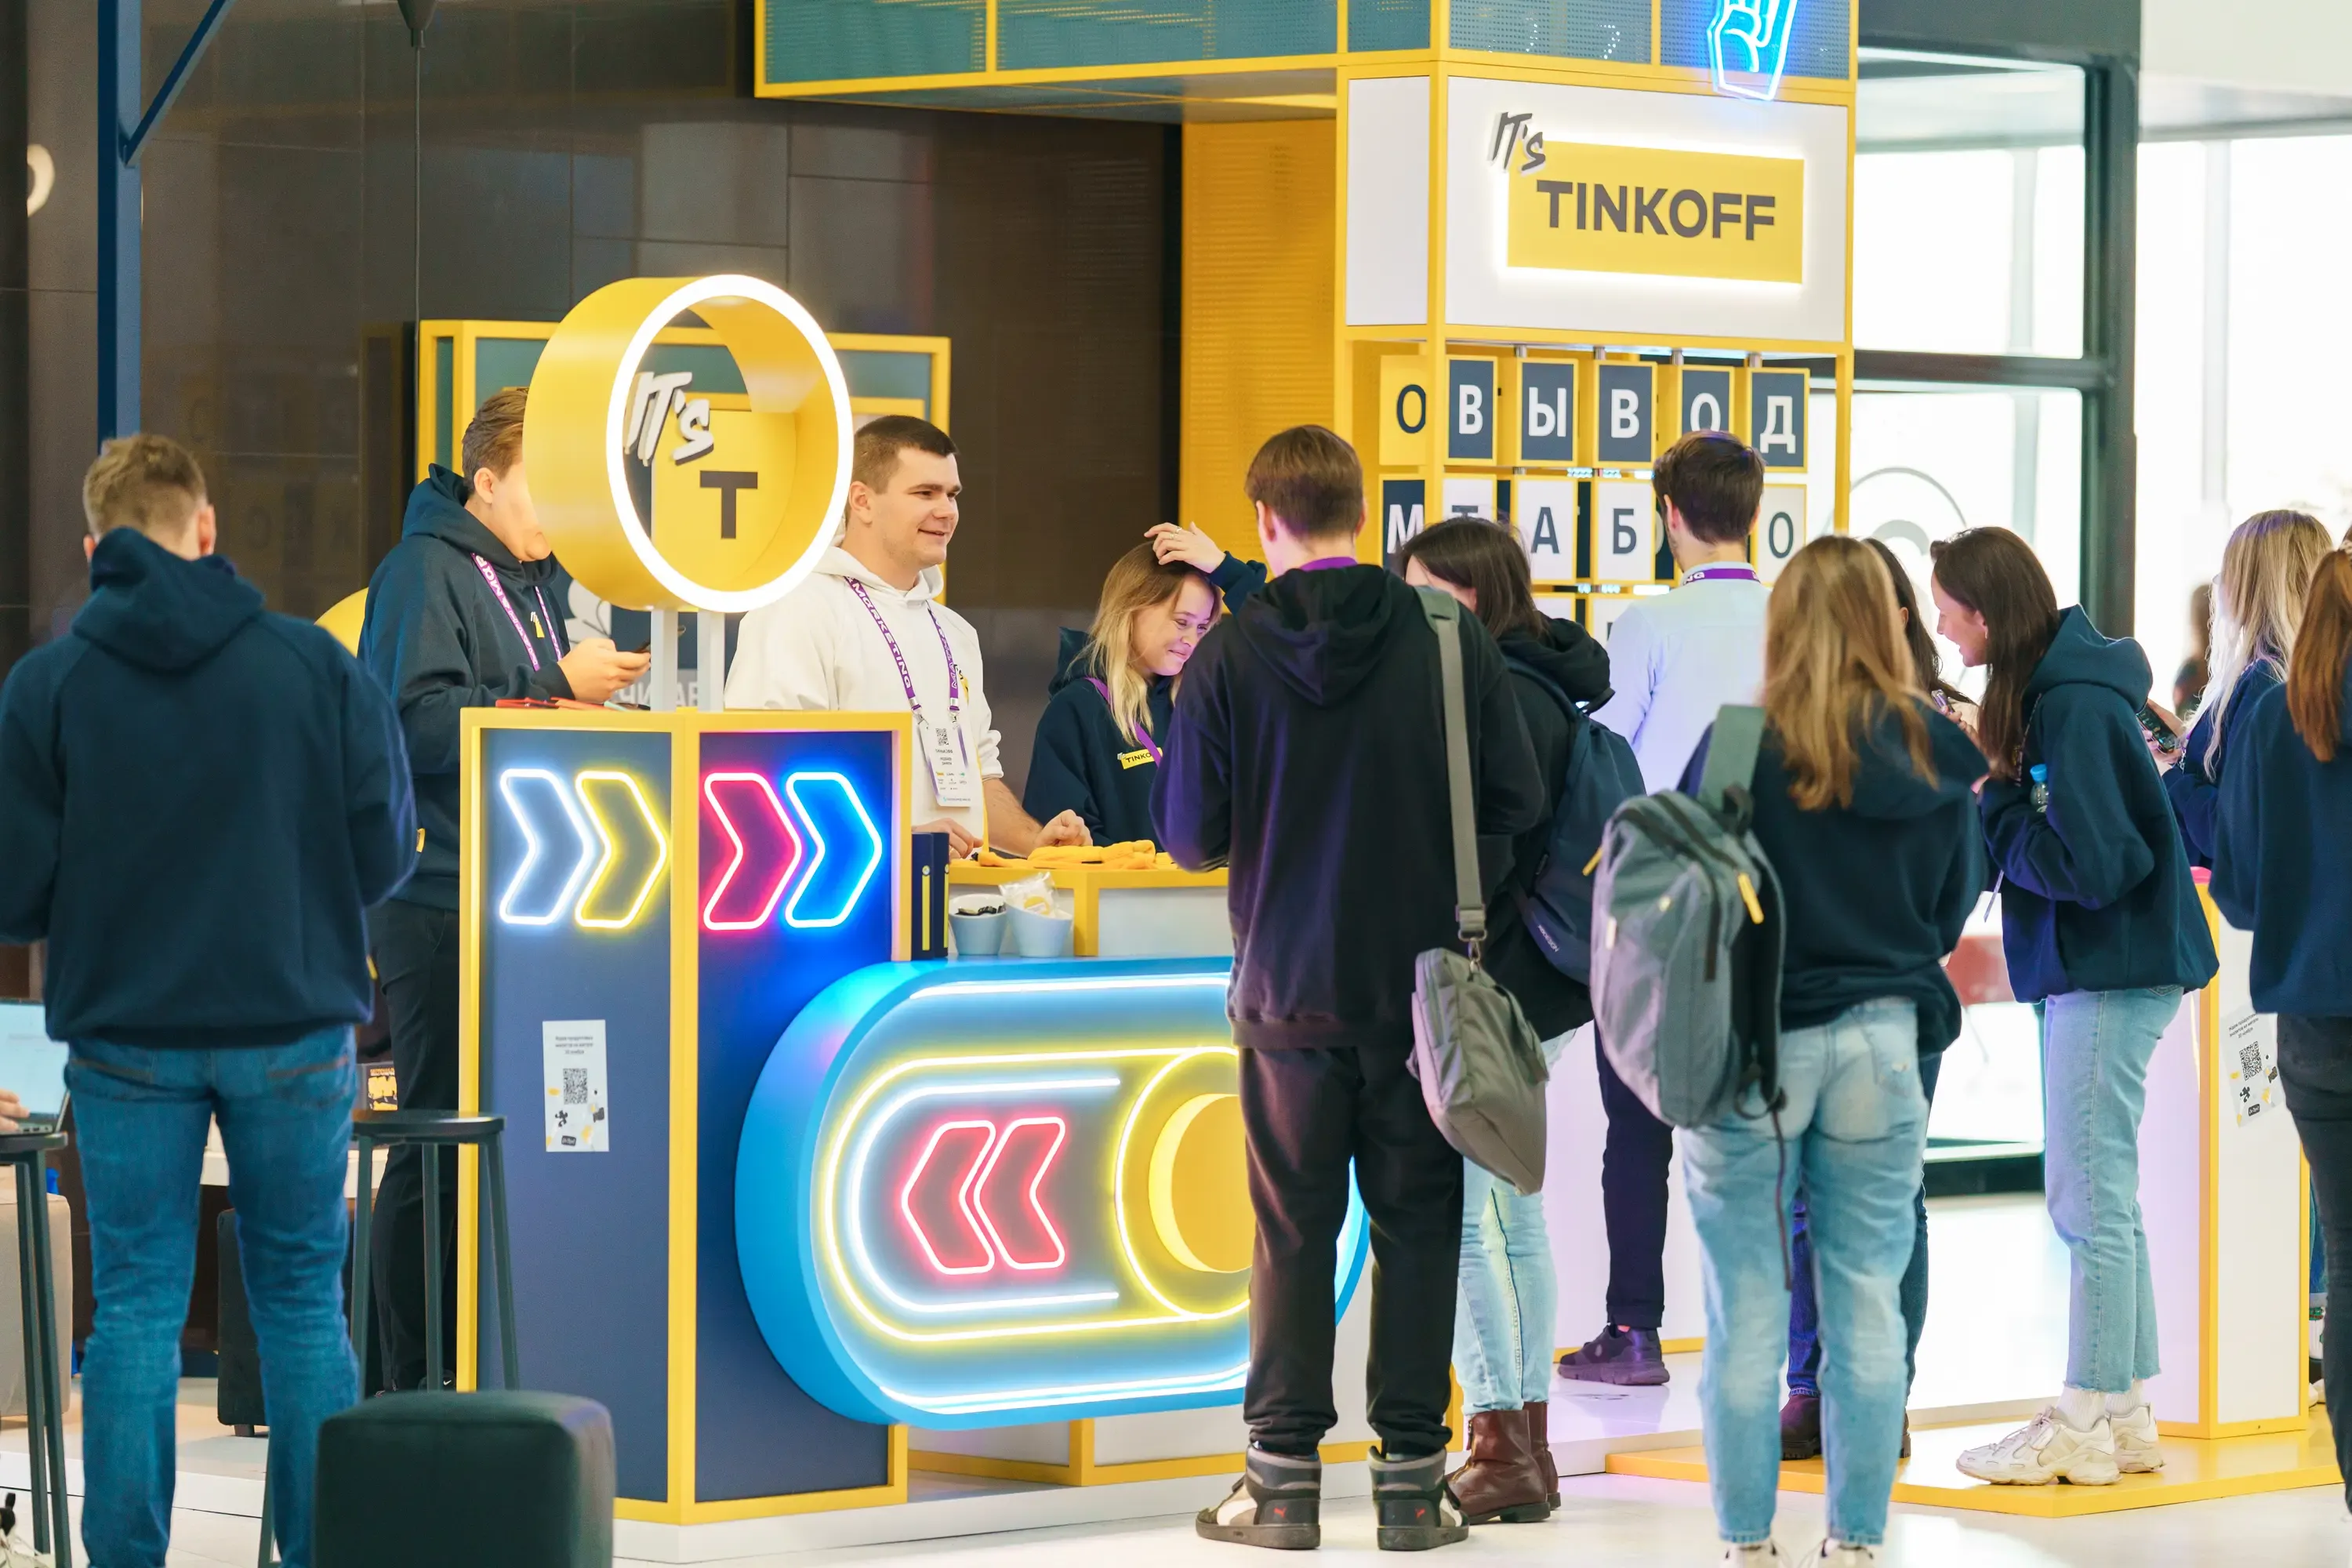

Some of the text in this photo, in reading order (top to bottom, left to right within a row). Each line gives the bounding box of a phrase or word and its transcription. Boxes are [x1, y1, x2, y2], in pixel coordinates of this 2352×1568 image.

[1537, 180, 1775, 241] TINKOFF
[699, 470, 758, 539] T
[1125, 752, 1152, 763] TINKO
